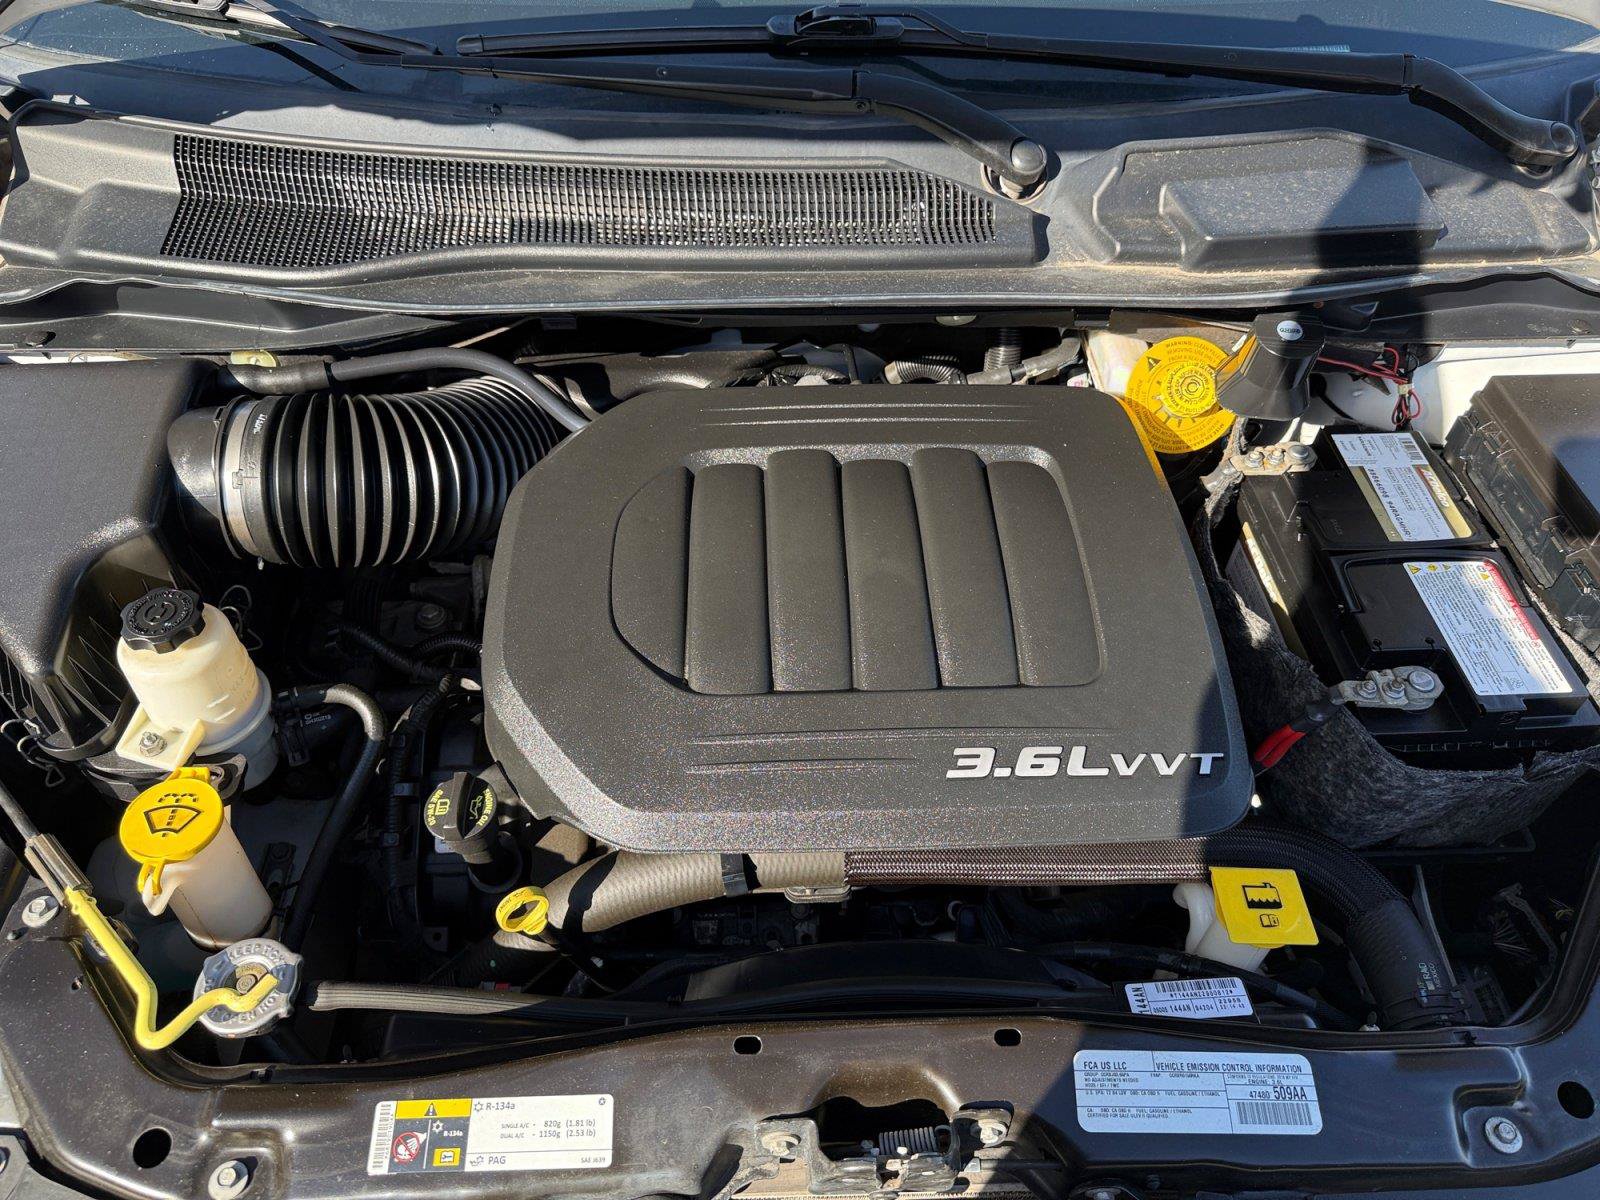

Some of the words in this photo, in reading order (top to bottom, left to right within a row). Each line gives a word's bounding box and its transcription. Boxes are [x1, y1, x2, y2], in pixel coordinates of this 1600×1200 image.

[946, 746, 1110, 778] 3.6L
[1110, 753, 1224, 776] VVT
[430, 789, 444, 803] SAE
[484, 788, 493, 815] ENGINE
[427, 803, 436, 826] 5W-20
[476, 814, 488, 826] OIL
[1084, 1062, 1098, 1070] FCA
[1156, 1062, 1184, 1071] VEHICLE
[1187, 1063, 1220, 1071] EMISSION
[1222, 1063, 1253, 1072] CONTROL
[1255, 1064, 1302, 1072] INFORMATION
[1273, 1086, 1307, 1100] 509AA
[486, 1102, 515, 1110] R-134a
[544, 1120, 561, 1128] 820g
[566, 1119, 584, 1128] (1.81
[586, 1118, 596, 1127] lb)
[539, 1130, 560, 1139] 1150g
[566, 1129, 584, 1138] (2.53
[586, 1128, 596, 1138] lb)
[488, 1156, 506, 1164] PAG
